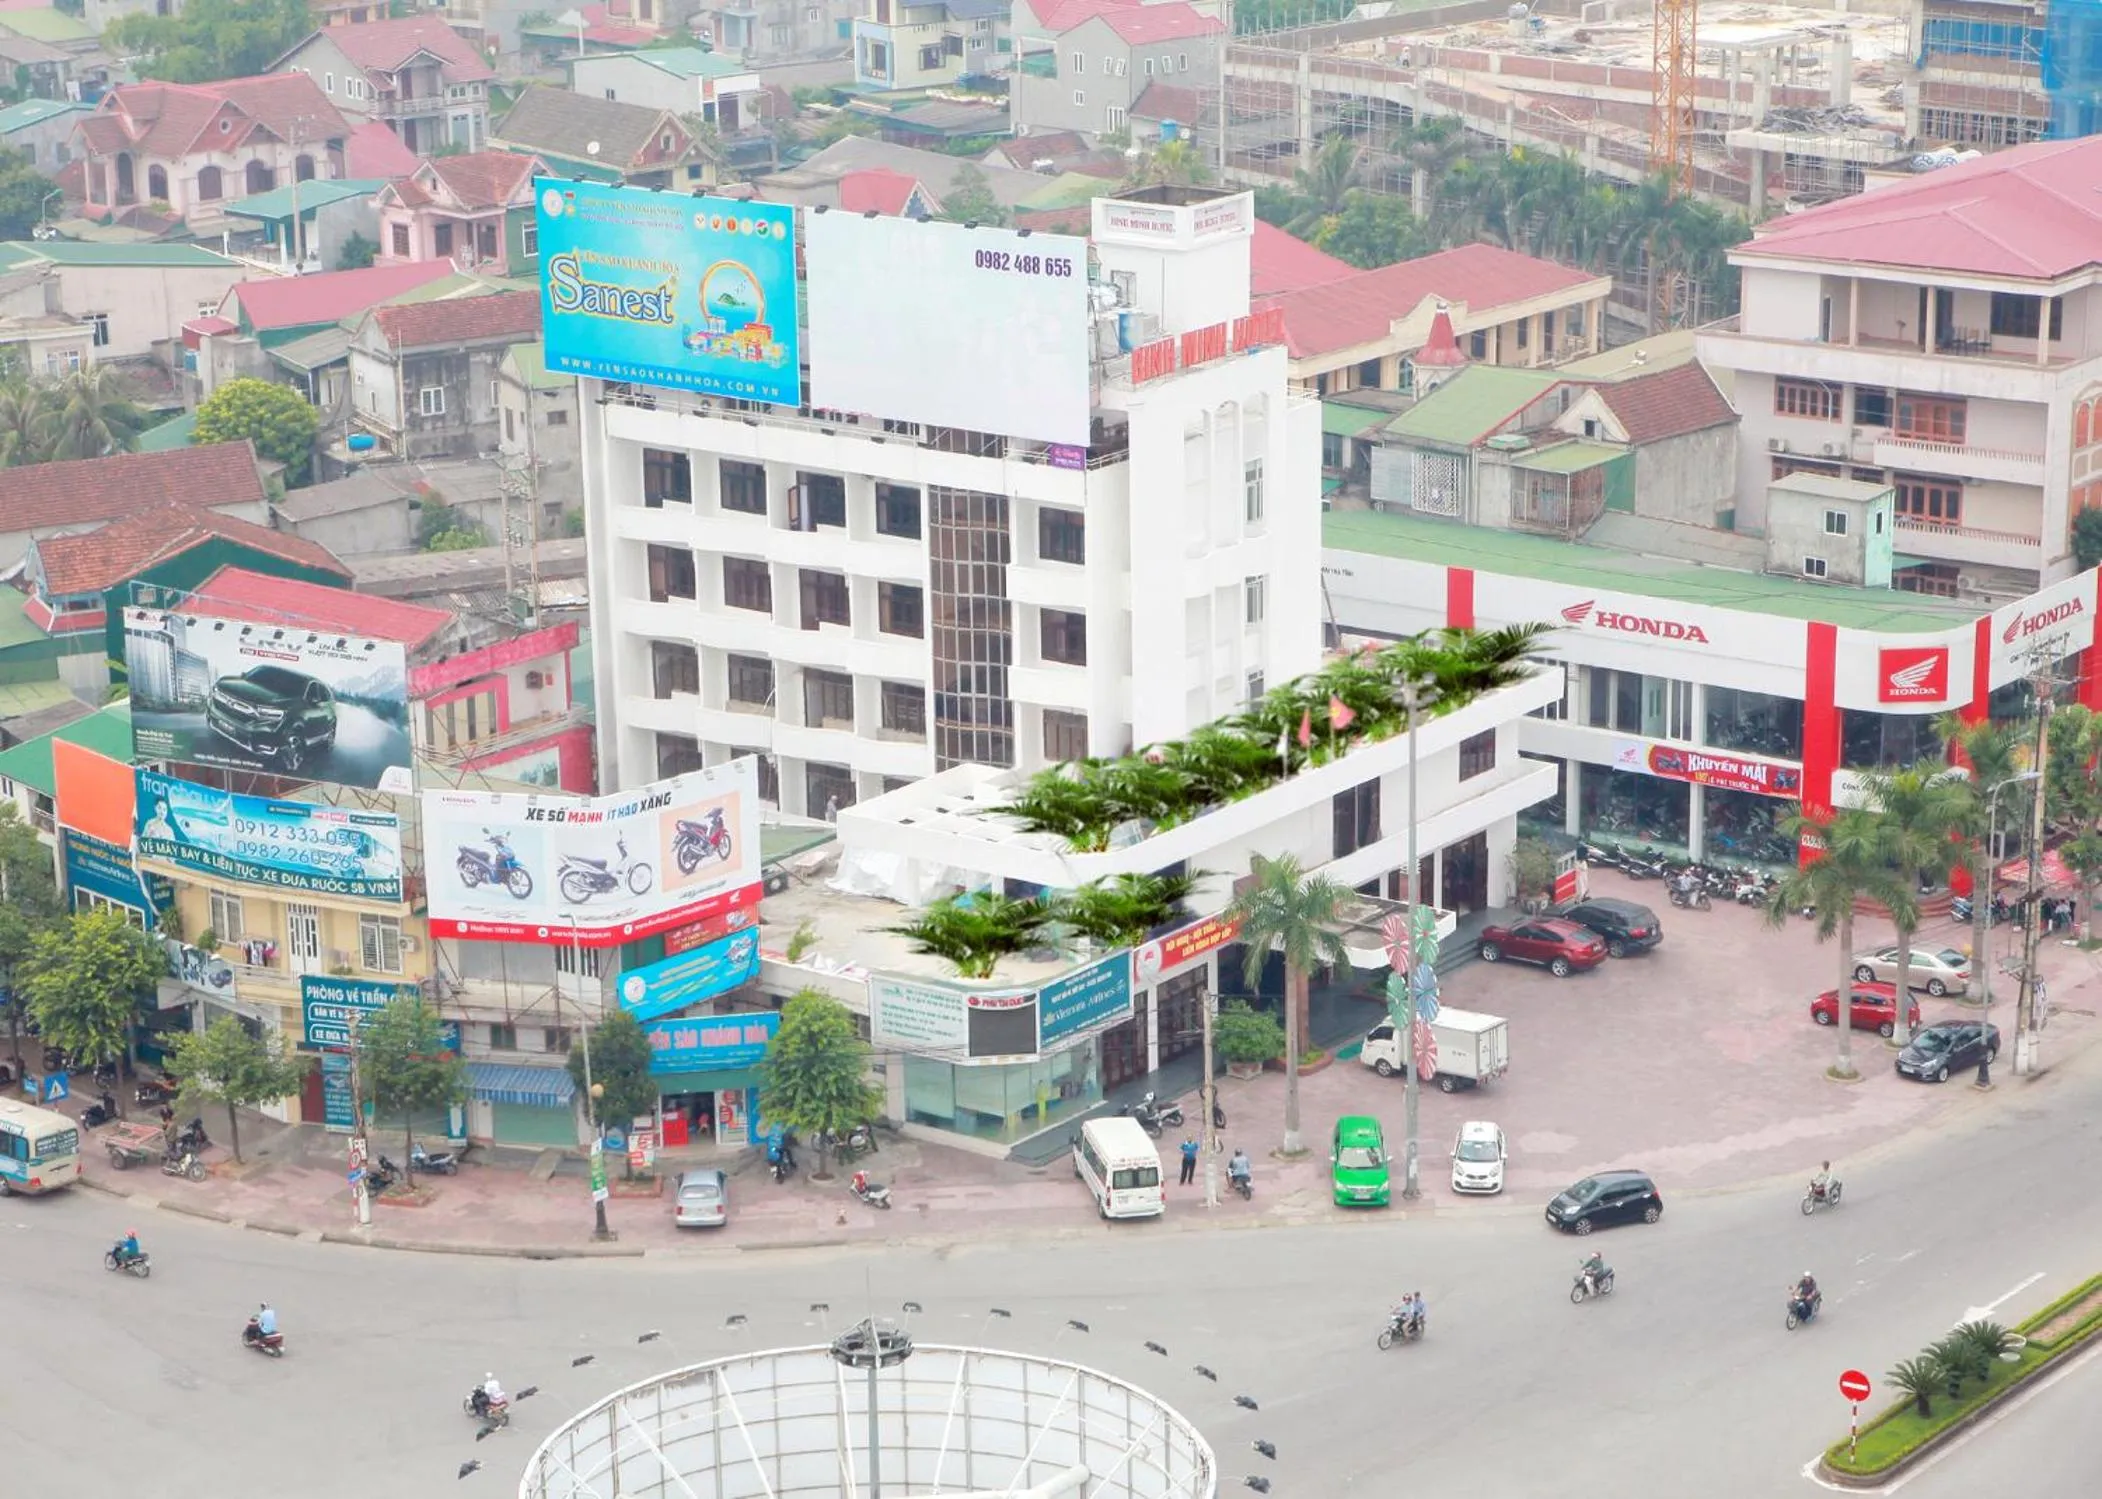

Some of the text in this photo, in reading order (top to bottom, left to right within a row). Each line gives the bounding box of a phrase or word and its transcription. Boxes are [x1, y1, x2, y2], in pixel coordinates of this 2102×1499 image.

[975, 249, 1072, 278] 0982 488 655
[551, 255, 674, 325] Sanest
[1595, 610, 1710, 645] HONDA
[2022, 597, 2084, 637] HONDA
[1889, 687, 1938, 697] HONDA
[525, 807, 545, 821] XE
[567, 811, 604, 827] MẠNH
[617, 804, 638, 818] HAO
[235, 818, 363, 851] 0912 333-055
[156, 841, 178, 855] MÁY
[180, 847, 201, 862] BAY
[202, 852, 211, 865] &
[235, 864, 258, 879] TỤC
[262, 869, 278, 882] XE
[367, 882, 398, 895] VINH
[236, 840, 363, 871] 0982 260-265
[306, 984, 345, 1002] PHÒNG
[315, 1029, 325, 1040] XE
